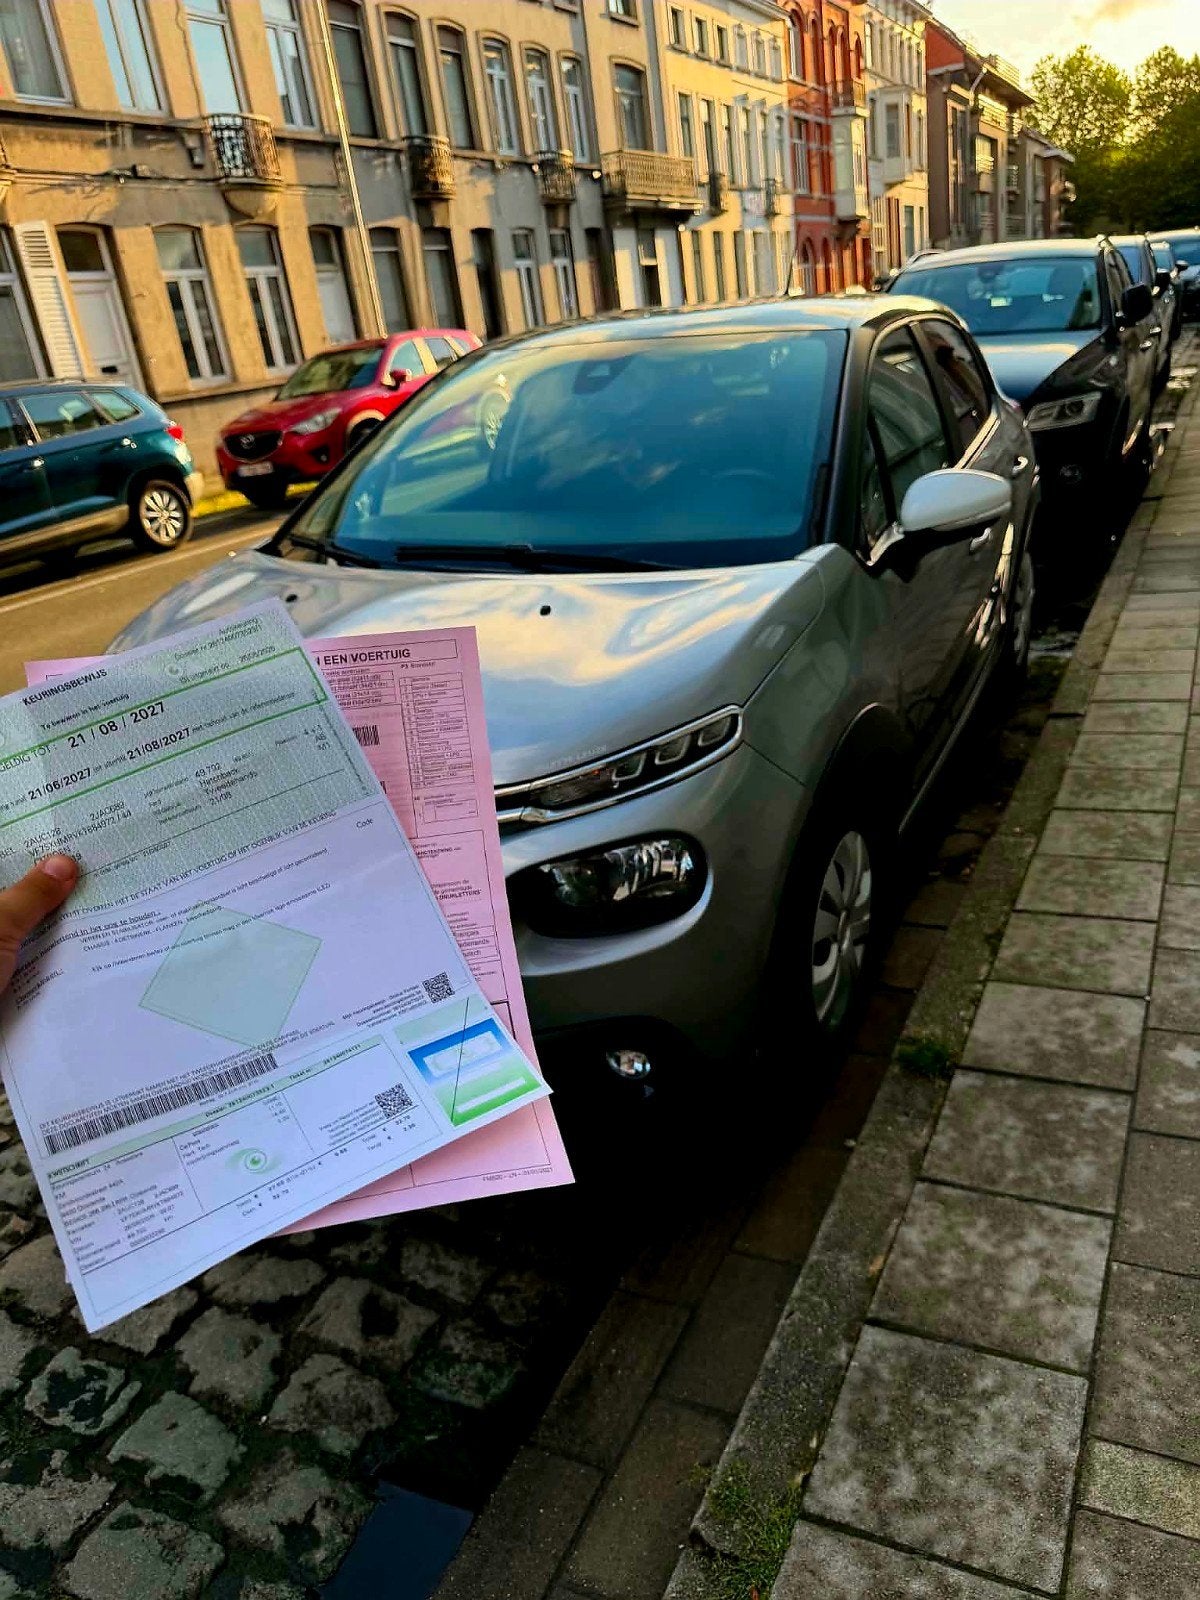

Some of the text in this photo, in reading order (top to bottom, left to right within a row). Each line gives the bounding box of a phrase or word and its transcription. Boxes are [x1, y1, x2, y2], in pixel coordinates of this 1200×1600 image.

[323, 653, 348, 665] EEN
[350, 648, 411, 663] VOERTUIG
[21, 668, 108, 706] KEURINGSBEWIJS
[67, 732, 86, 748] 21
[98, 719, 118, 736] 08
[129, 701, 166, 723] 2027
[27, 767, 93, 800] 21/06/2027
[126, 727, 192, 760] 21/08/2027
[355, 816, 373, 828] Code
